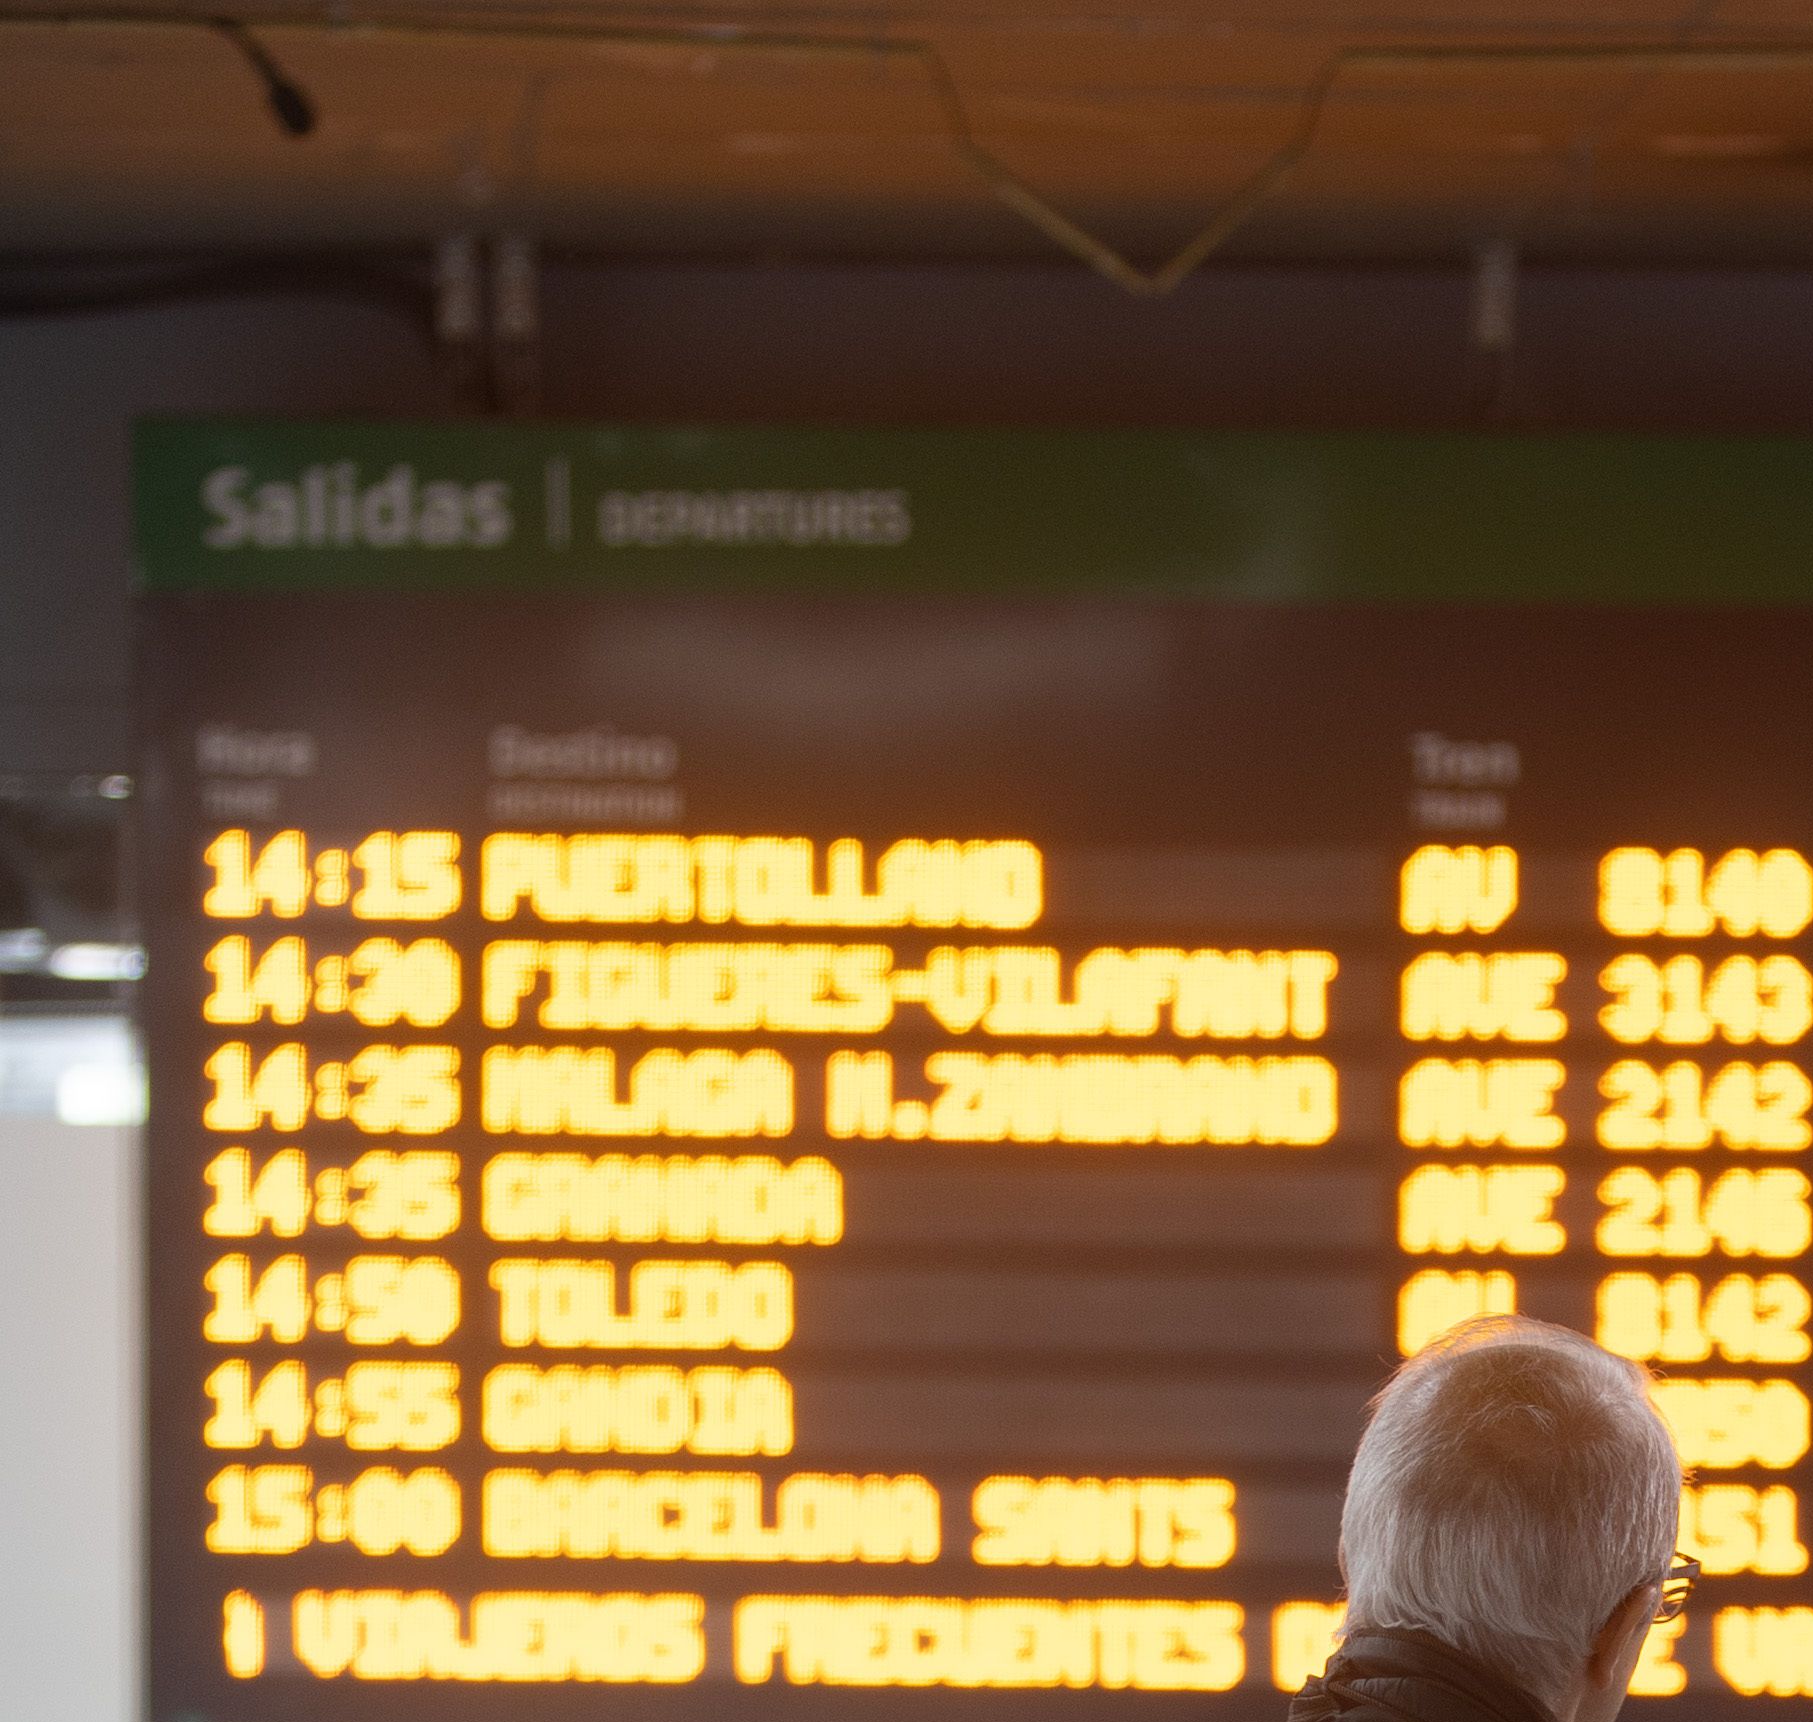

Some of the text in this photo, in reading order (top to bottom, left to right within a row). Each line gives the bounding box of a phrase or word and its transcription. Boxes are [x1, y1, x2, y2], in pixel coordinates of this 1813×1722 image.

[204, 464, 912, 549] Salidas DEPARTURES
[204, 830, 462, 920] 14:15
[481, 833, 1043, 929] PUERTOLLANO
[204, 936, 461, 1027] 14:30
[482, 940, 1338, 1039] FIGUERES-VILAFANT
[1401, 952, 1567, 1042] AVE
[1599, 954, 1813, 1044] 3143
[204, 1042, 461, 1134] 14:35
[482, 1045, 794, 1138] MALAGA
[1399, 1058, 1566, 1149] AVE
[1596, 1060, 1813, 1151] 2142
[204, 1148, 461, 1240] 14:35
[1399, 1164, 1566, 1254] AVE
[204, 1254, 461, 1345] 14:50
[489, 1259, 794, 1350] TOLEDO
[205, 1360, 461, 1451] 14:55
[482, 1364, 794, 1456] GANDIA
[206, 1465, 461, 1556] 15:00
[482, 1468, 941, 1563] BARCELONA
[972, 1476, 1236, 1568] SANTS
[292, 1590, 706, 1683] VIAJEROS
[733, 1595, 1245, 1691] FRECUENTES
